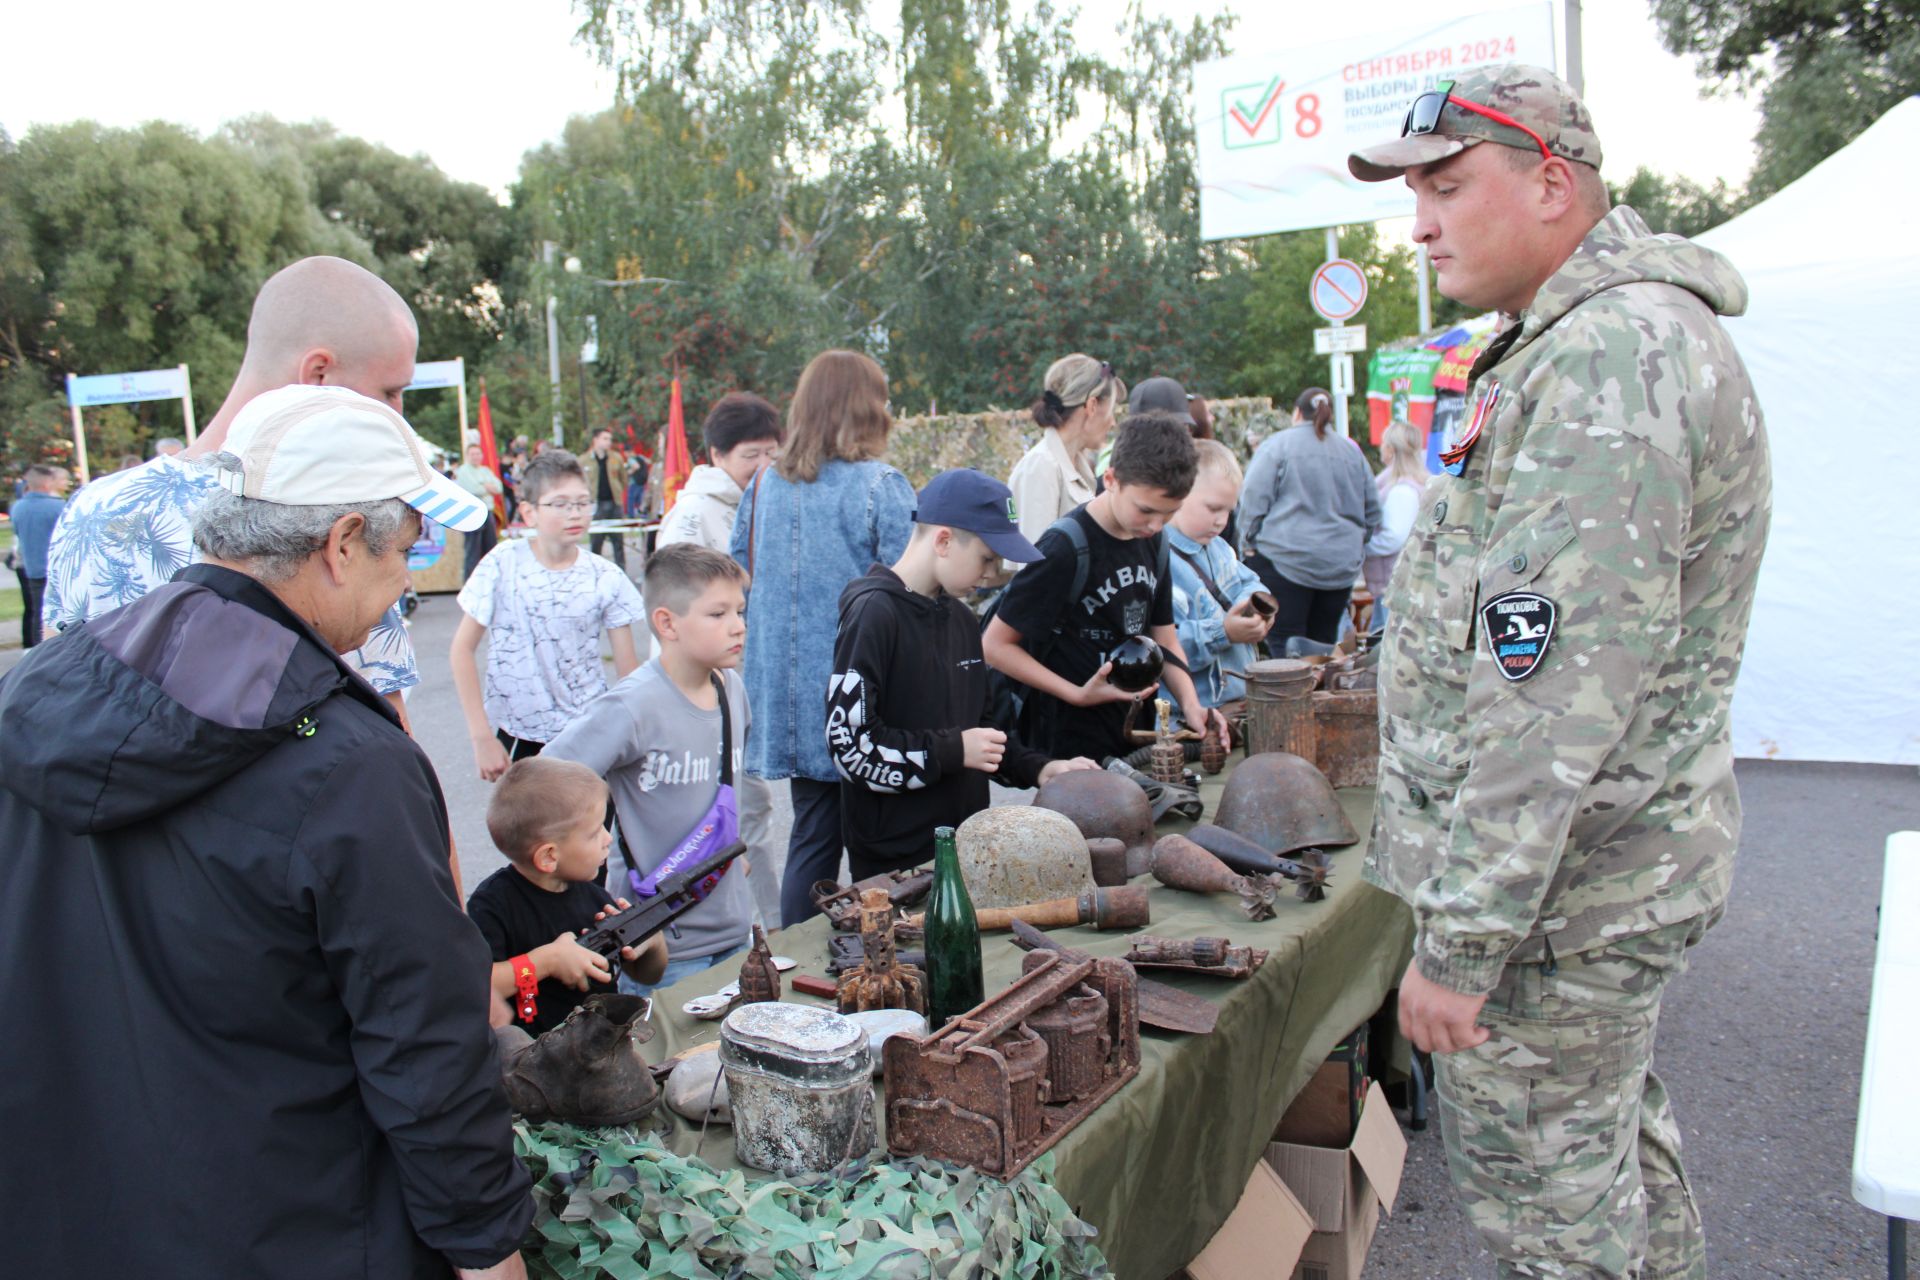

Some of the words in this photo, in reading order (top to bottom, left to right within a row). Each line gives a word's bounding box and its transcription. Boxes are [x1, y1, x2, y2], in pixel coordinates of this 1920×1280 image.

[1343, 46, 1452, 83] СЕНТЯБРЯ
[1461, 35, 1517, 65] 2024
[1344, 76, 1417, 102] ВЫБОРЫ
[1295, 93, 1322, 138] 8
[638, 750, 711, 792] Palm
